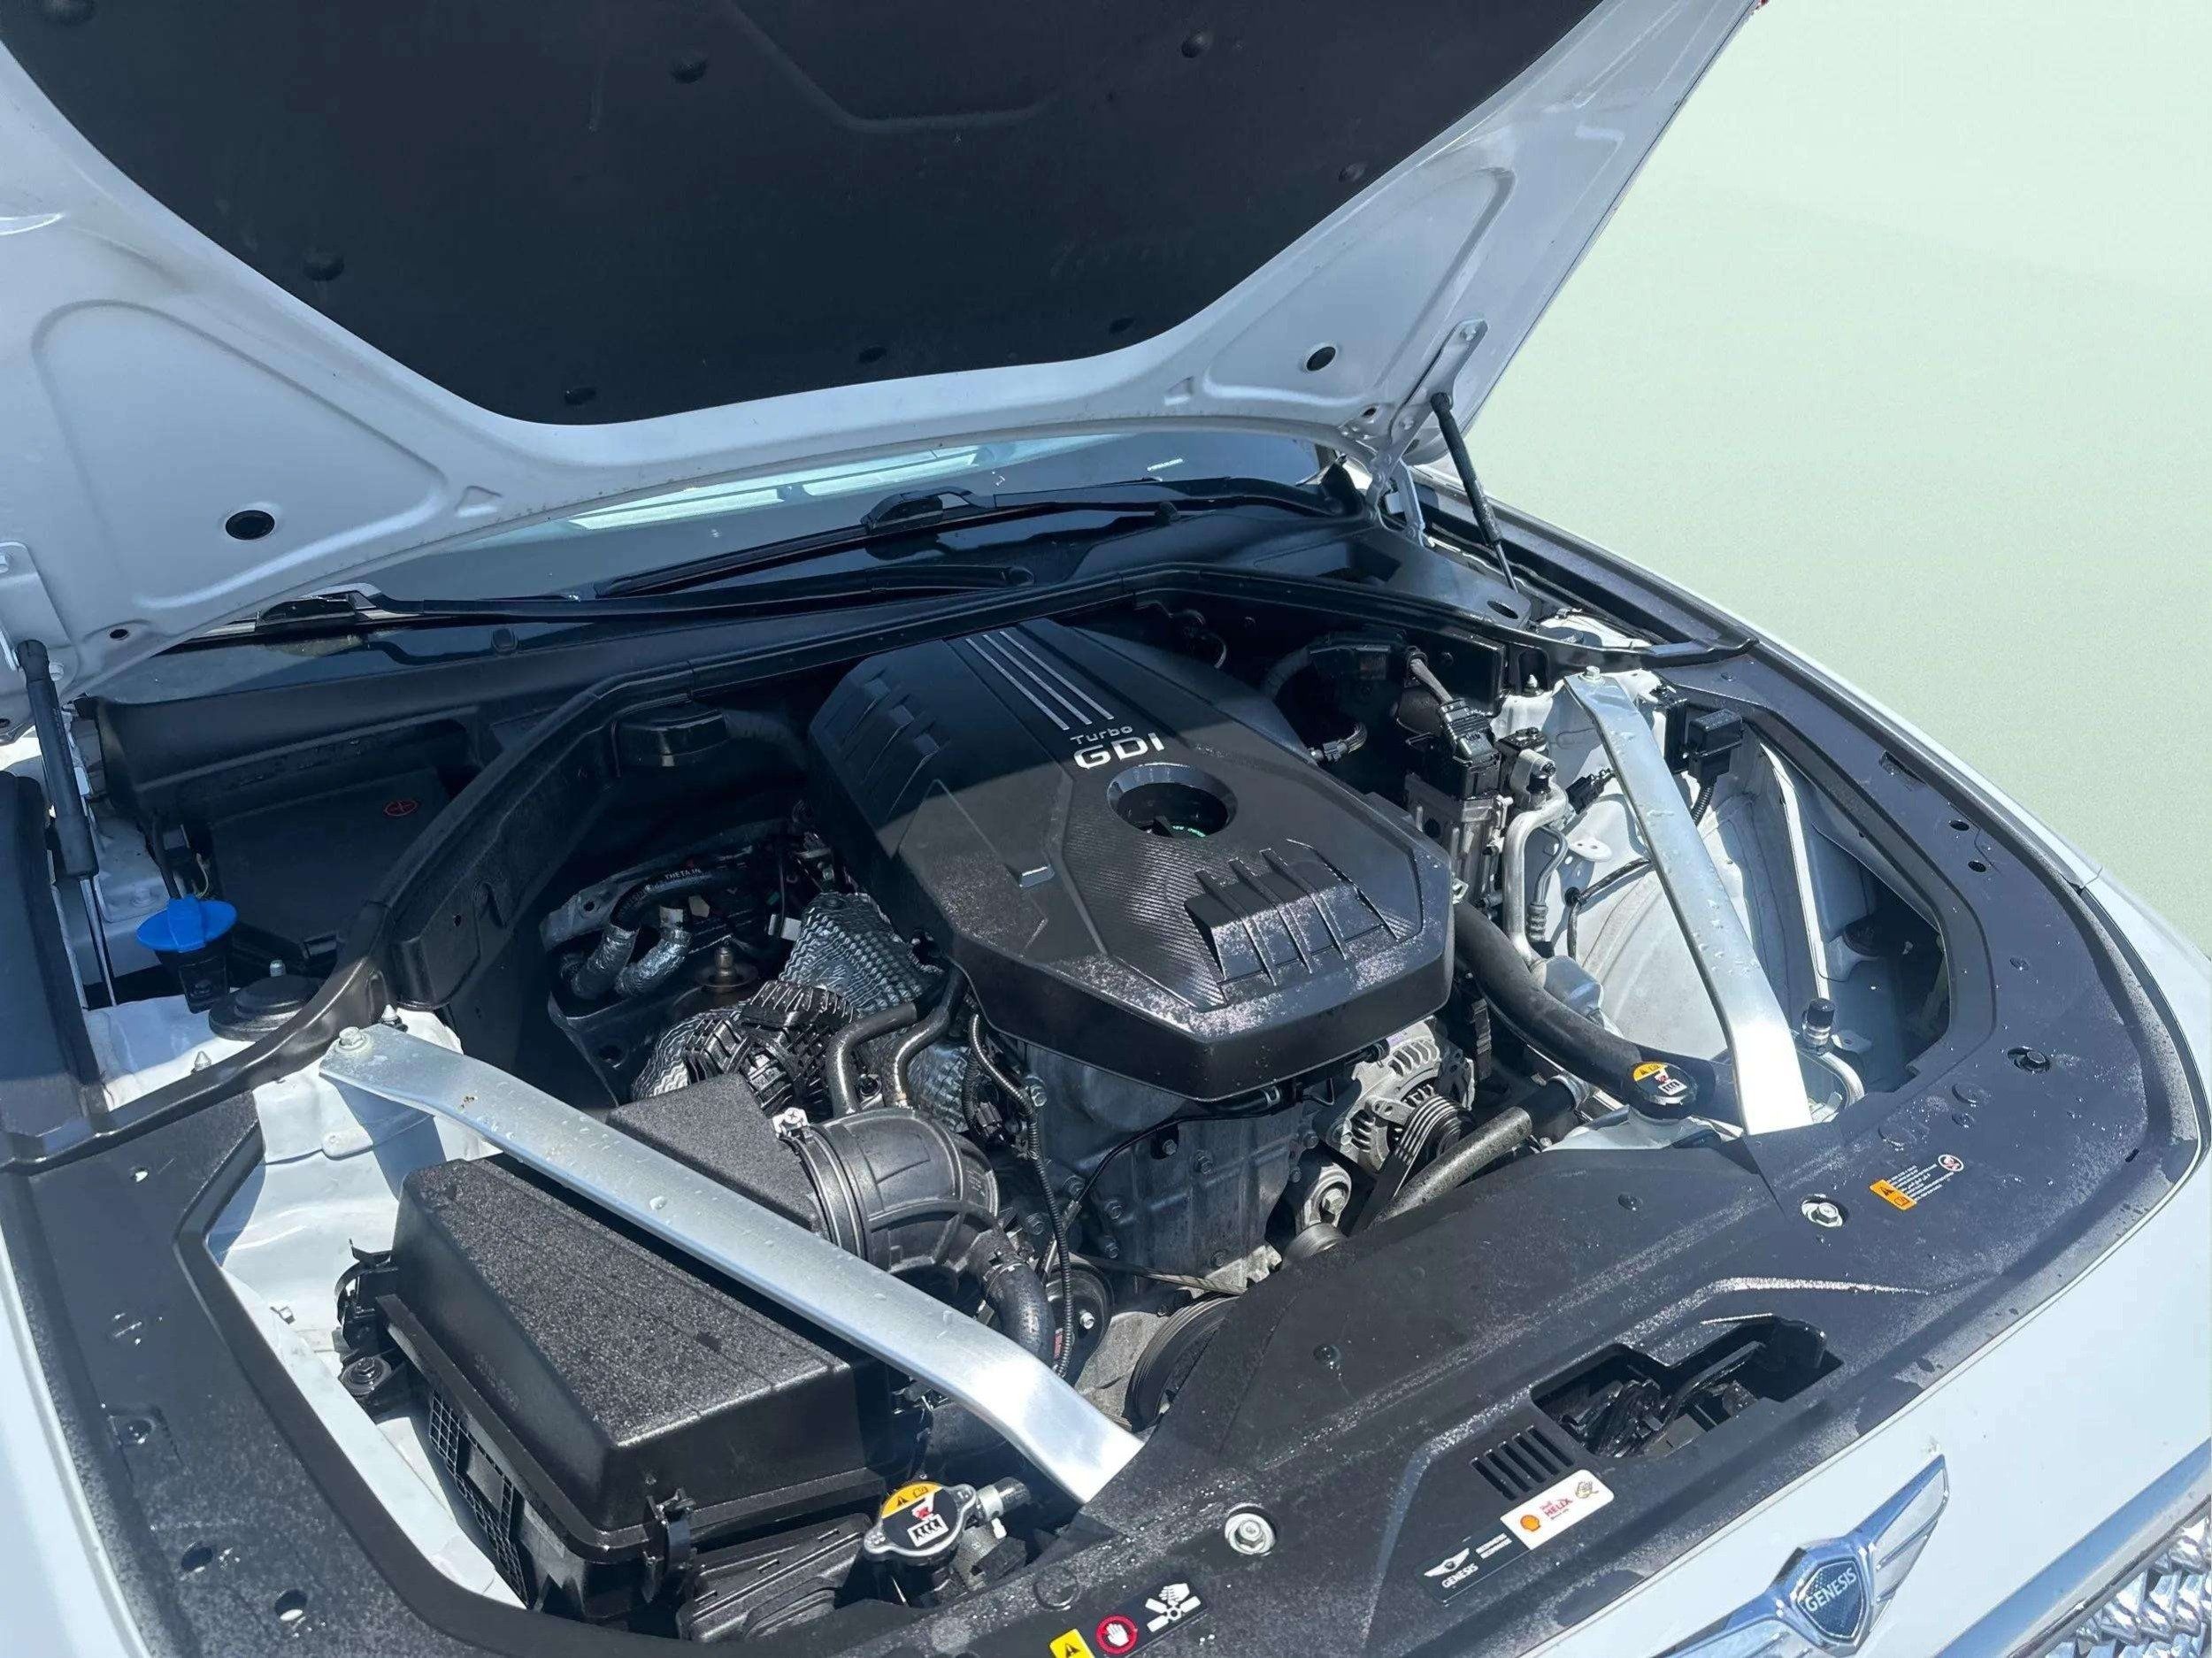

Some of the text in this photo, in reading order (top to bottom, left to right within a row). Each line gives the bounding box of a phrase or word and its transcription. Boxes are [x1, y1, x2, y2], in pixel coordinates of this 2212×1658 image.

[1070, 725, 1133, 745] Turbo
[1073, 733, 1164, 769] GDI
[1544, 1498, 1573, 1516] HELIX
[1441, 1562, 1479, 1588] GENESIS
[1805, 1567, 1857, 1612] GENESIS
